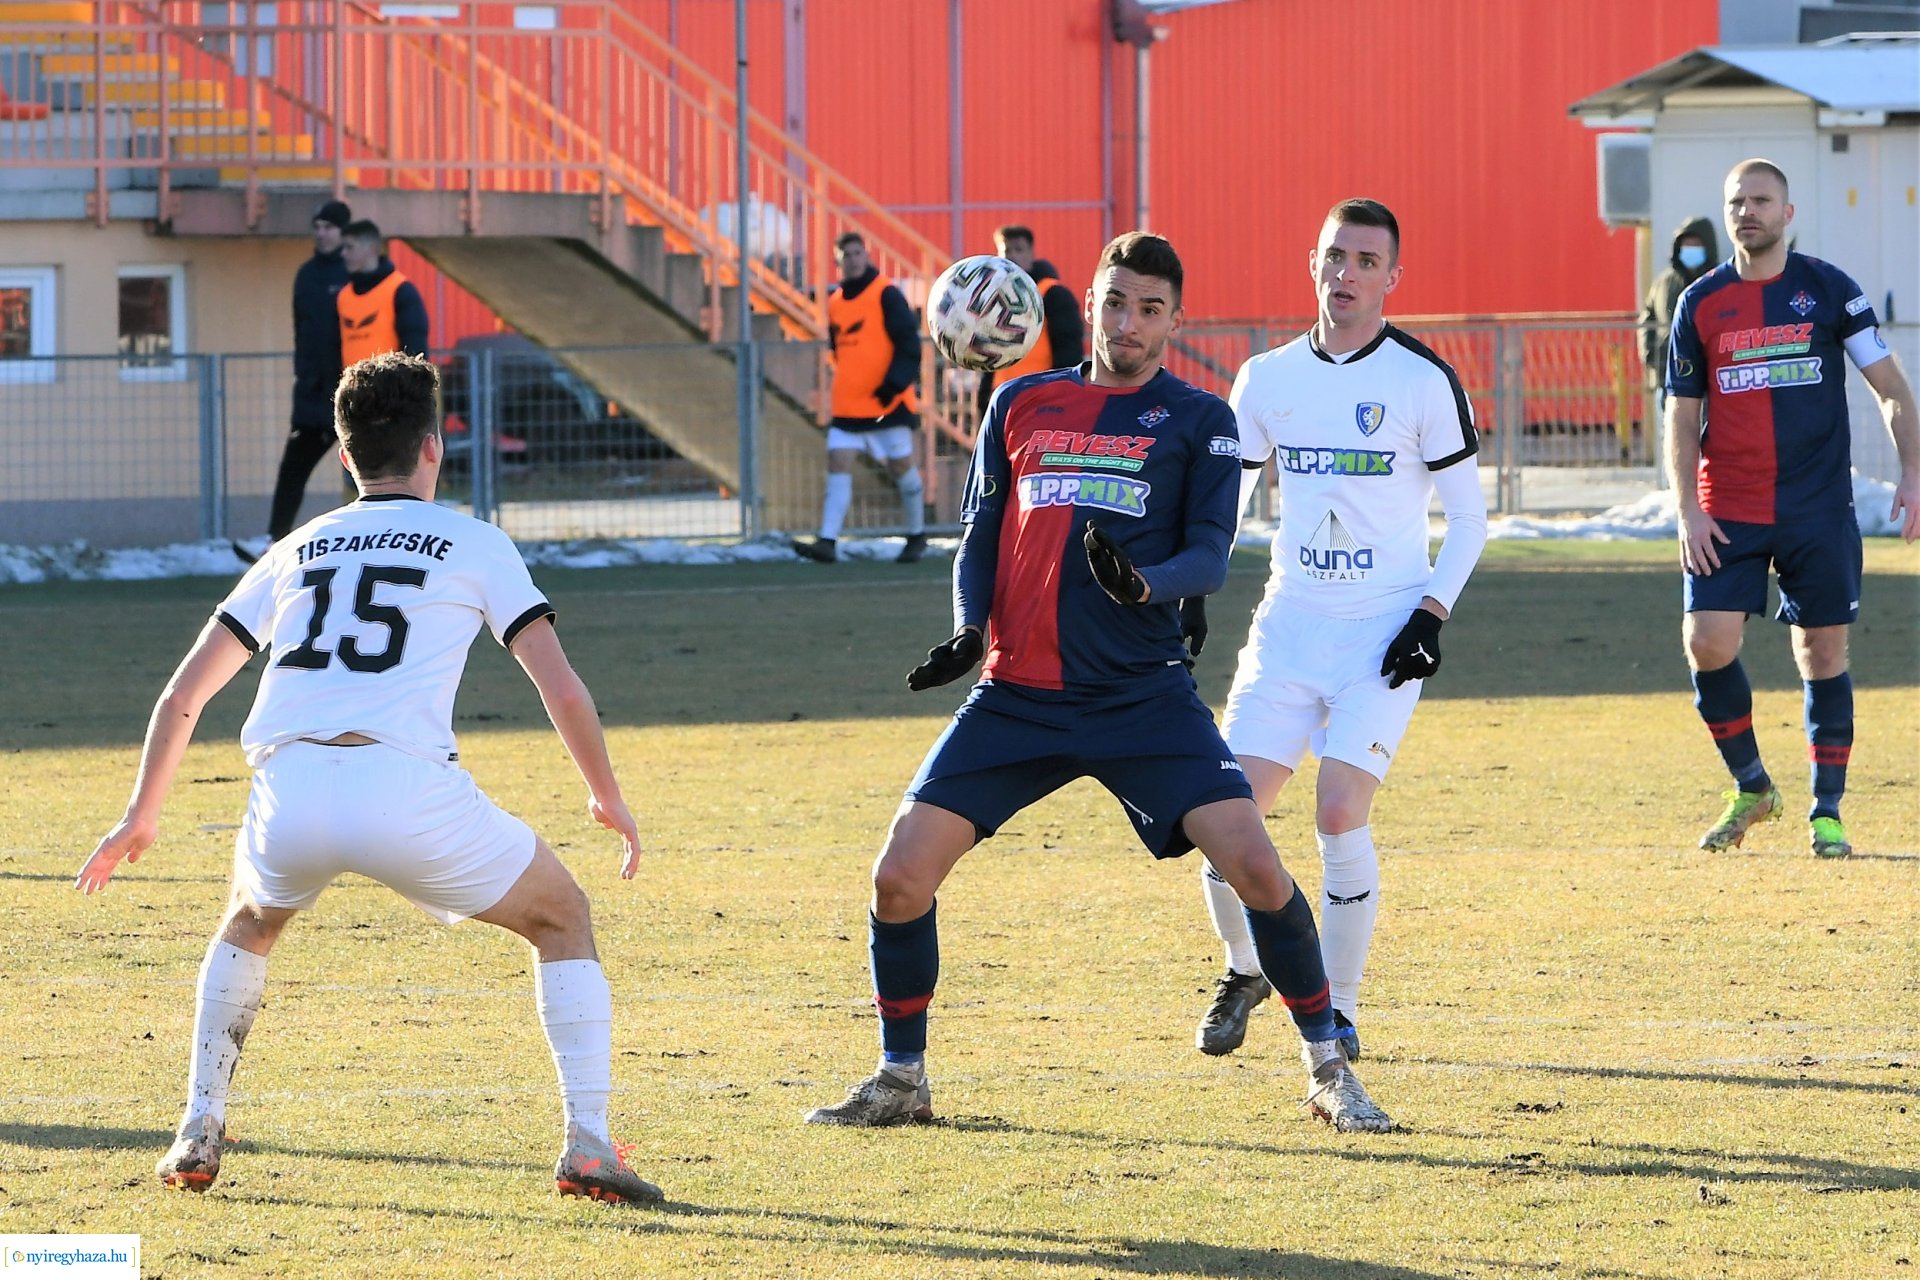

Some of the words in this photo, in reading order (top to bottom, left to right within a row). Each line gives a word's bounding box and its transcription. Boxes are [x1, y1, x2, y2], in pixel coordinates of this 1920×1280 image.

[1719, 322, 1814, 353] REVESZ
[1024, 429, 1157, 460] REVESZ
[295, 529, 454, 564] TISZAKÉCSKE
[275, 562, 430, 674] 15
